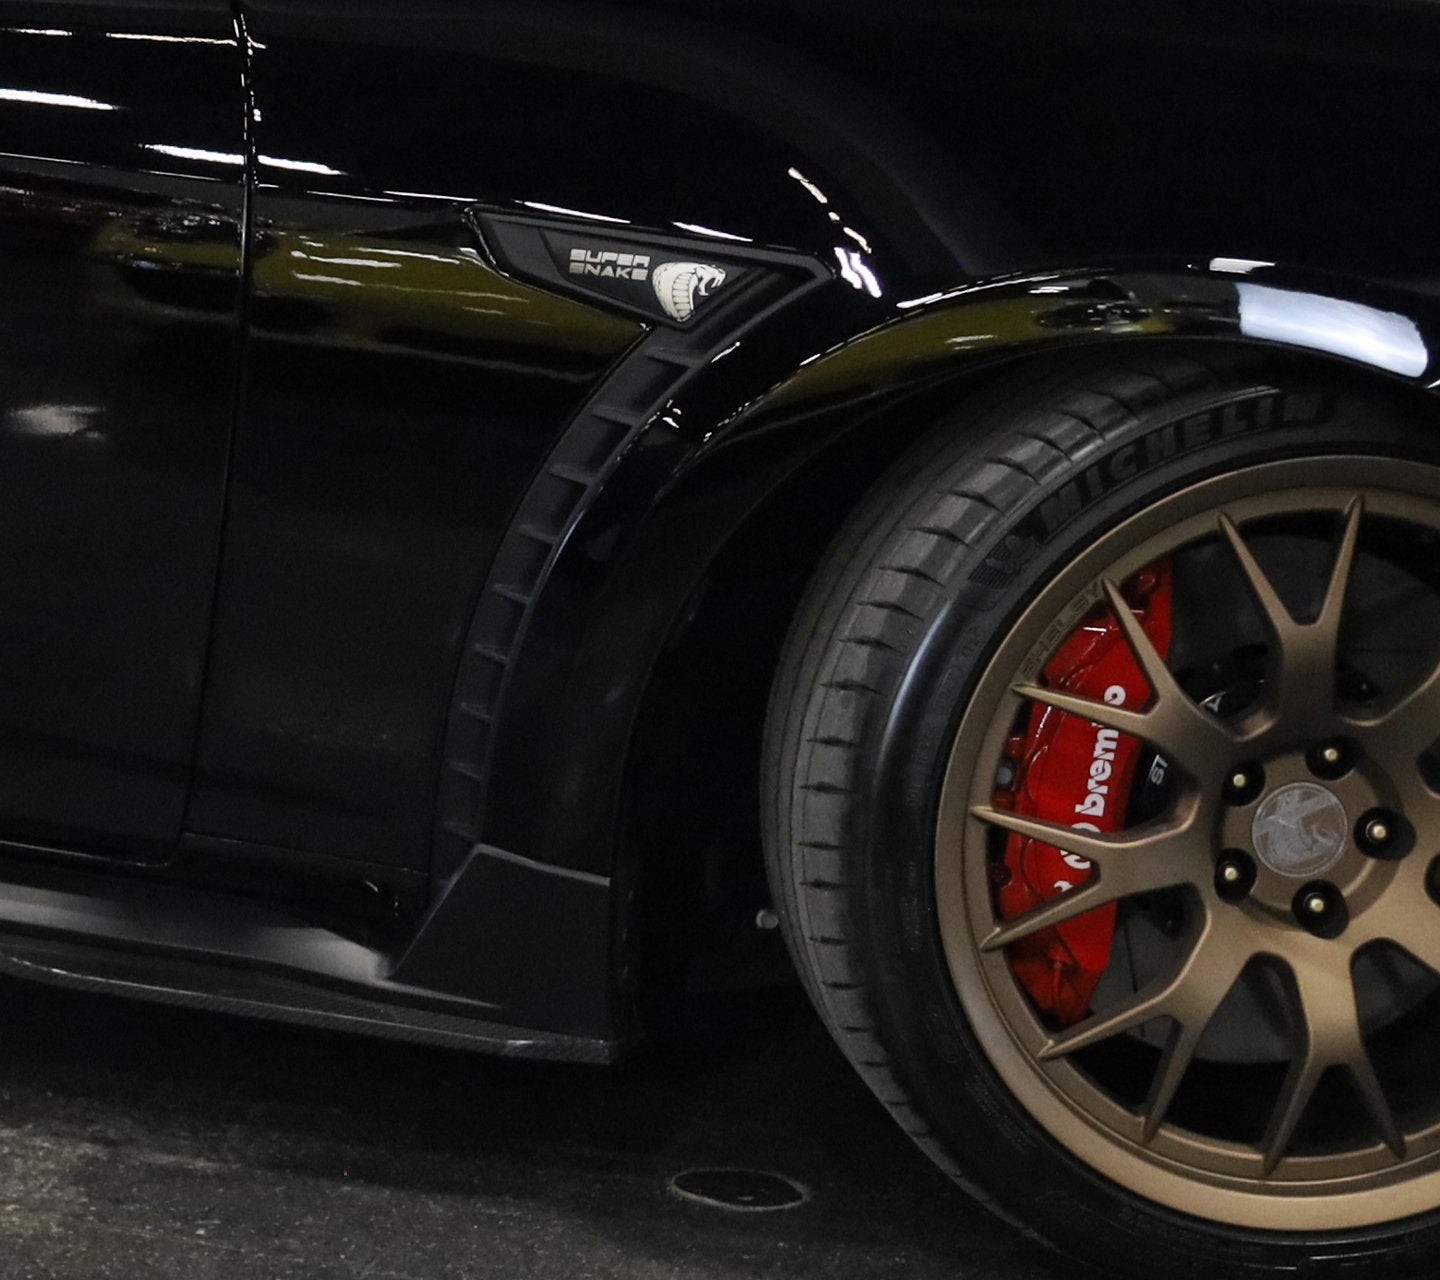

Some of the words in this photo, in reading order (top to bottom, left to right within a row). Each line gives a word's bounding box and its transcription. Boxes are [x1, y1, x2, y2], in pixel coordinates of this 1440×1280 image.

[568, 262, 649, 281] SNAKE
[569, 249, 651, 268] SUPER
[1038, 393, 1323, 535] MICHELIN
[1074, 684, 1127, 817] bremo
